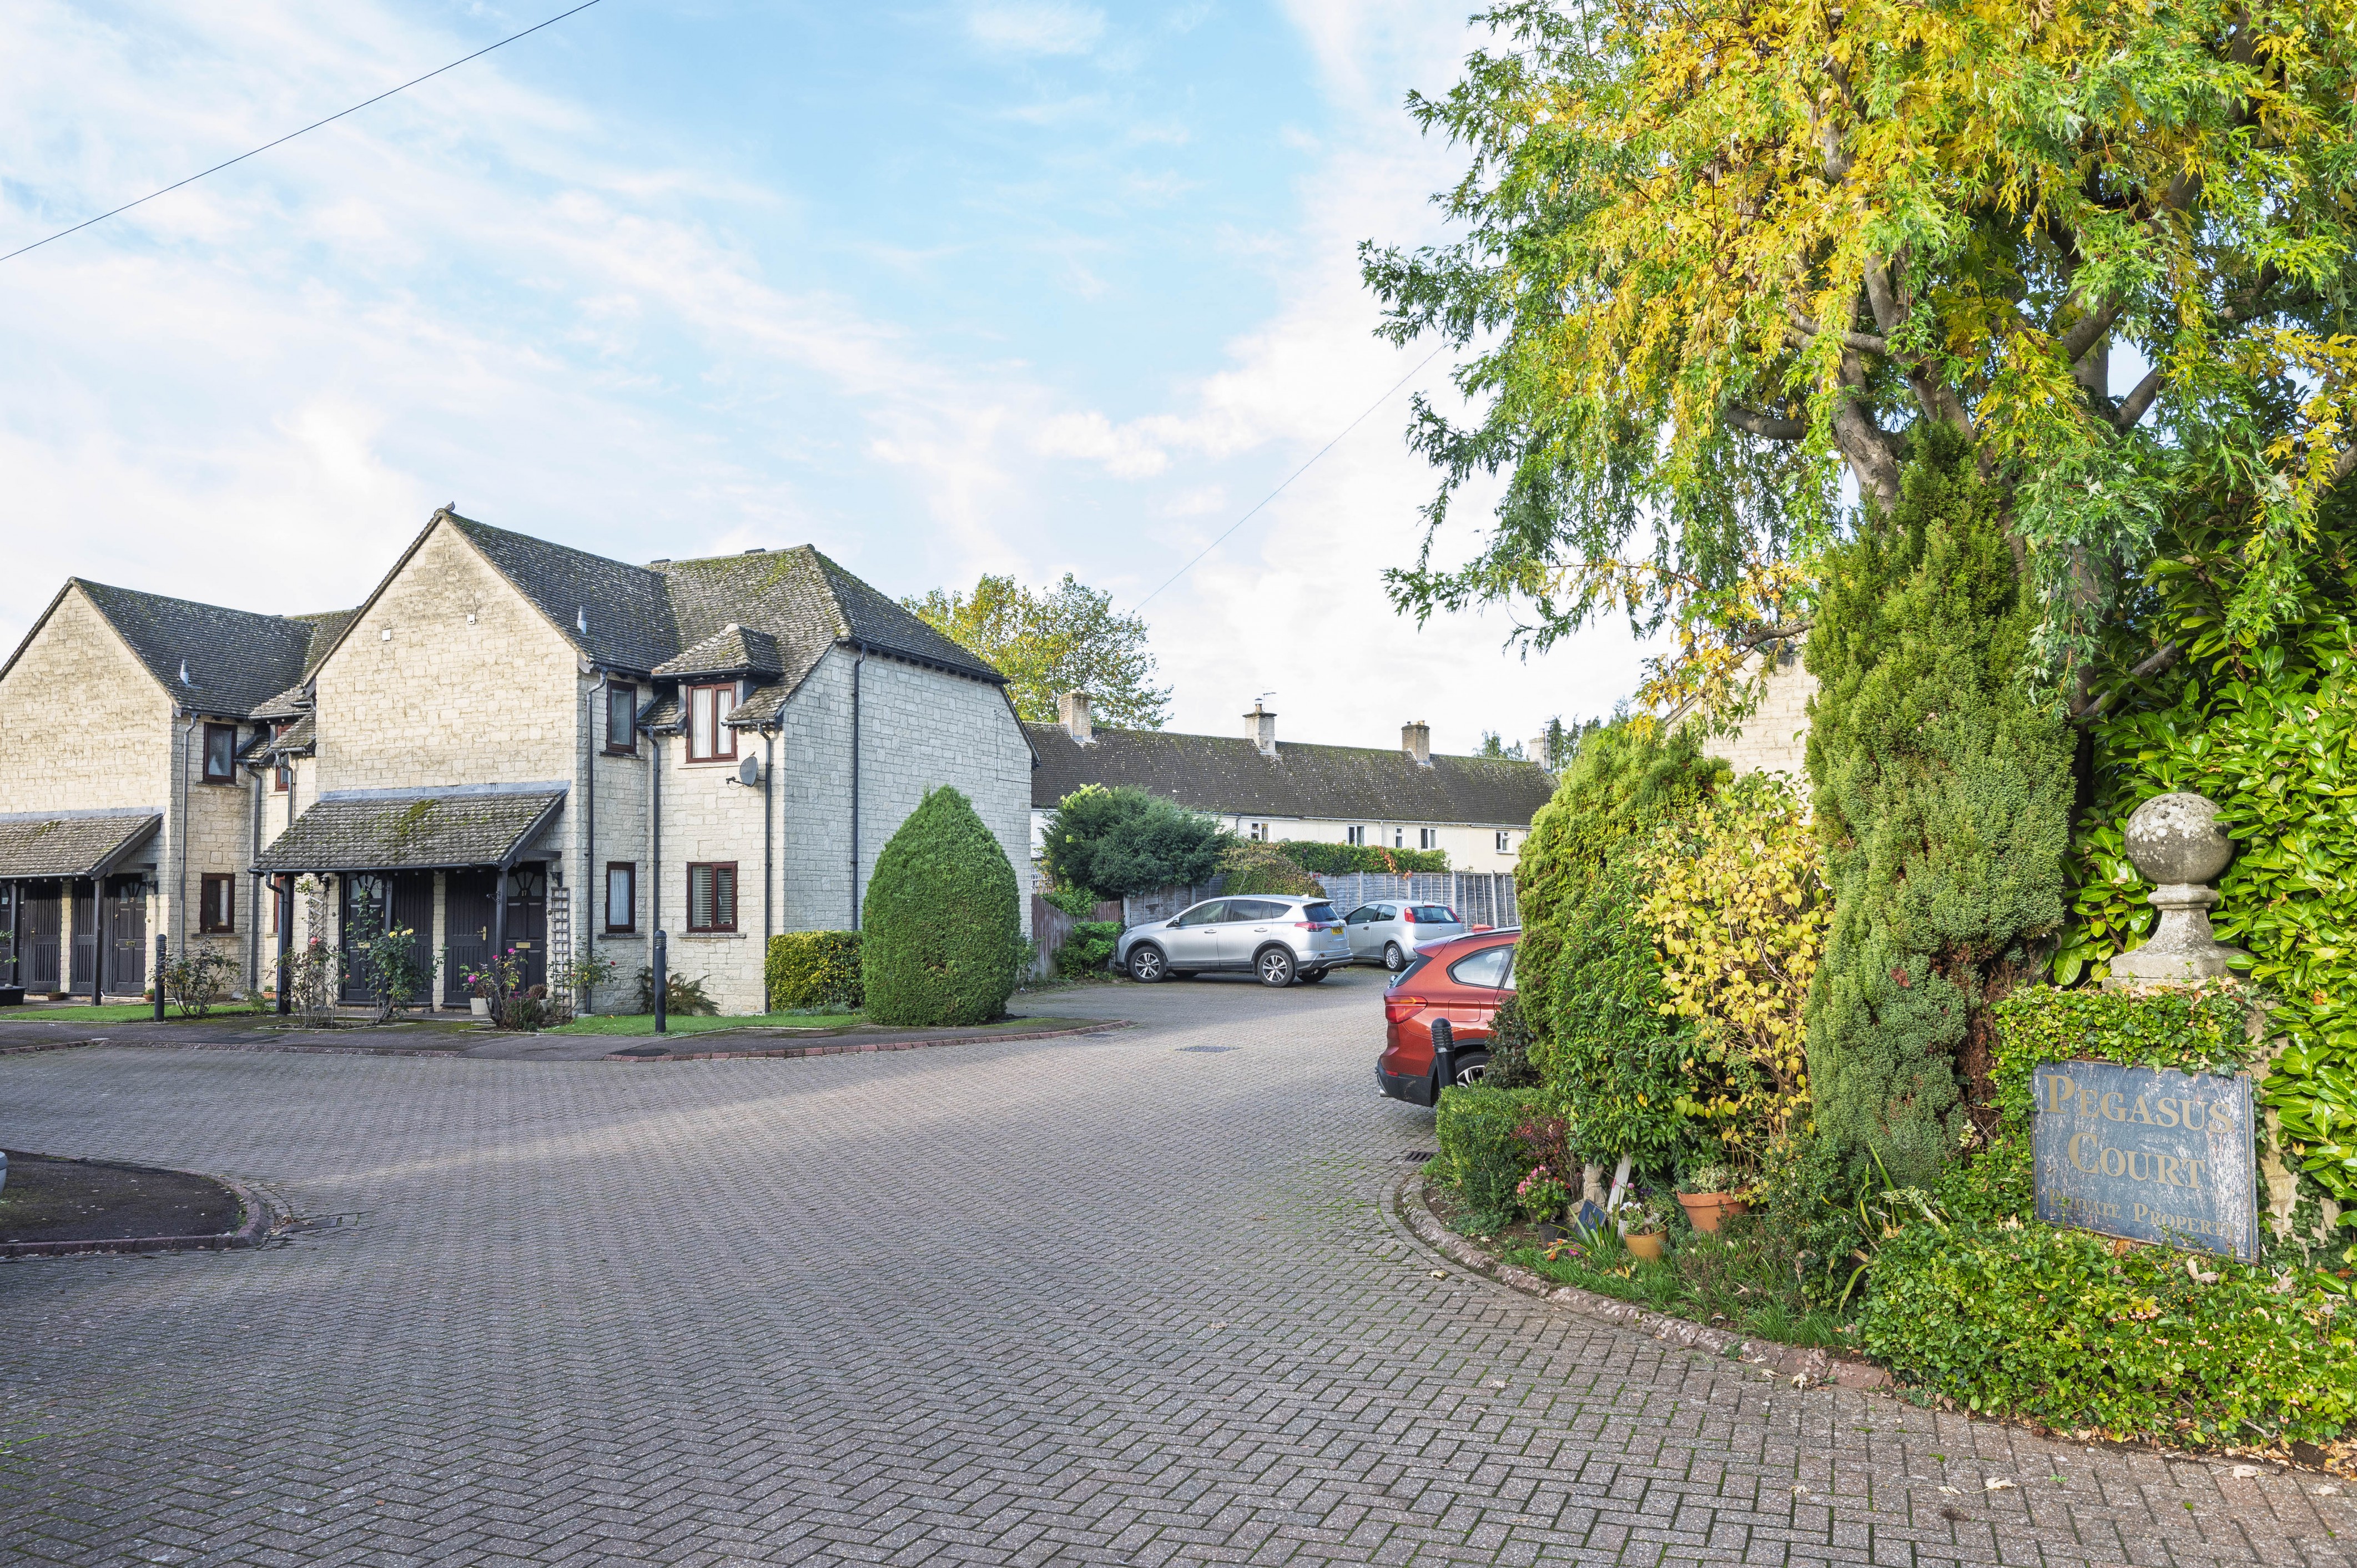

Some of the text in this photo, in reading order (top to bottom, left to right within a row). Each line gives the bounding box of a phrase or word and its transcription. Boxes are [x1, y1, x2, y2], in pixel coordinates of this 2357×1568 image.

[2043, 1074, 2234, 1133] PEGASUS
[2068, 1132, 2206, 1189] COURT
[2132, 1202, 2237, 1240] PROPERTY
